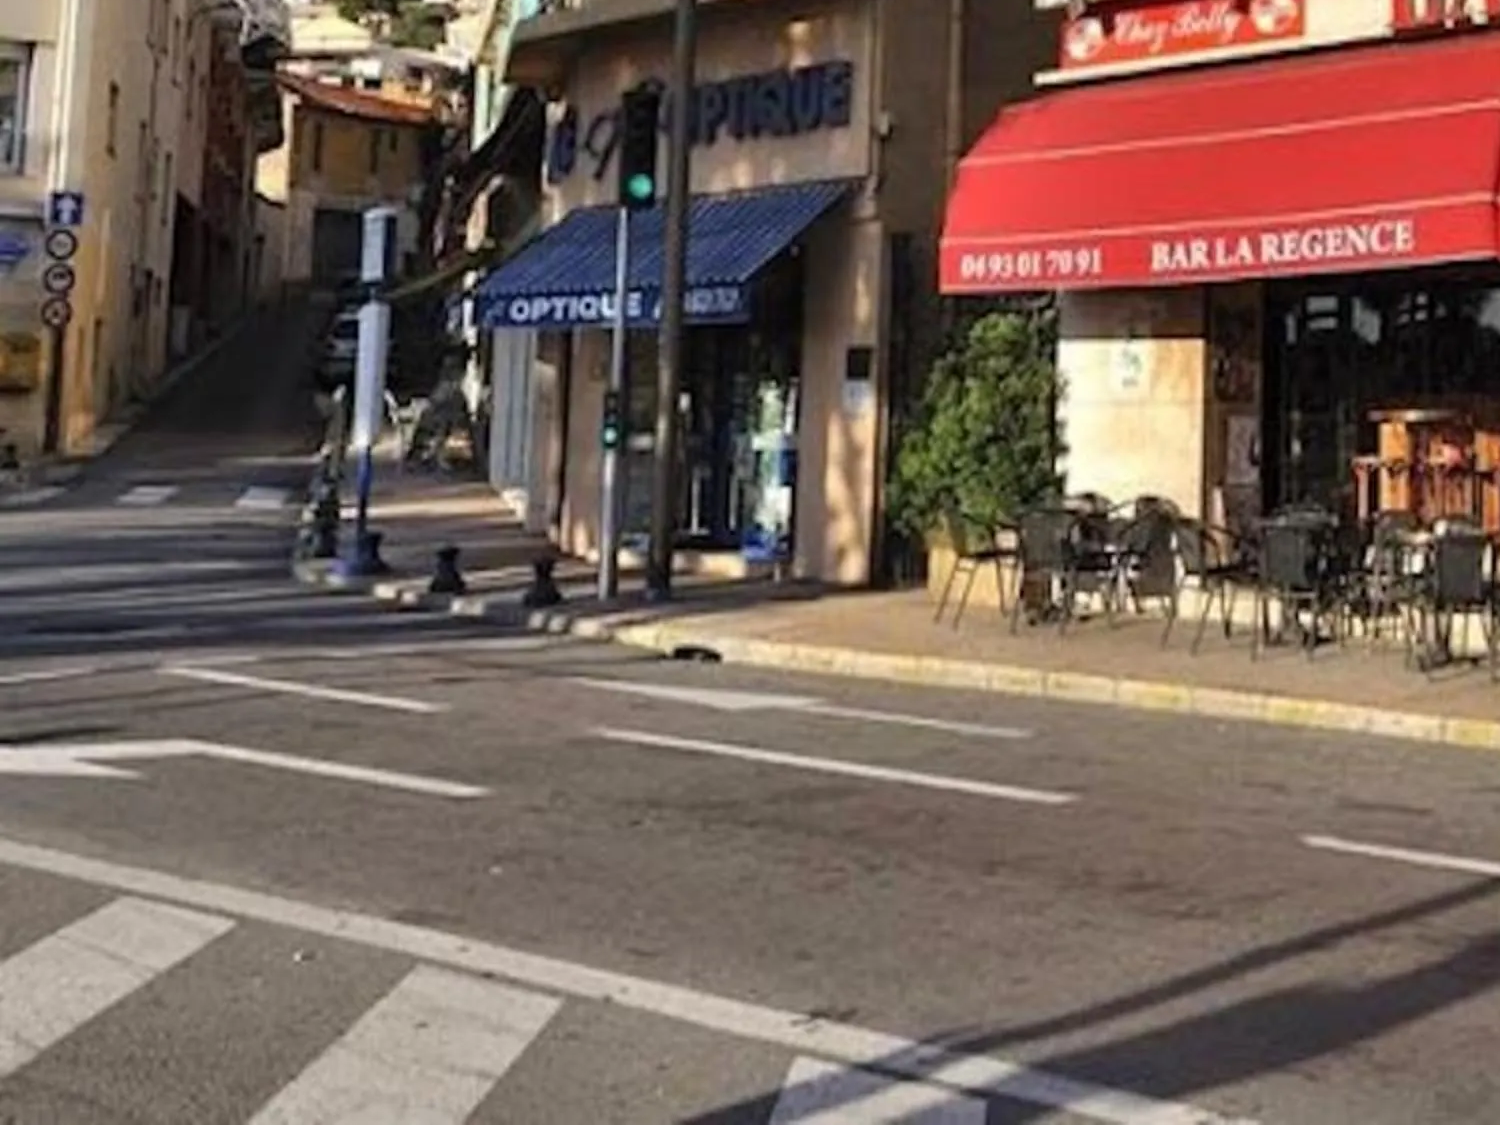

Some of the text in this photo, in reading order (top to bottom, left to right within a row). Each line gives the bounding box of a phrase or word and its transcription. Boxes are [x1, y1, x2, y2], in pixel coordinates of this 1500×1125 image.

[1151, 220, 1416, 271] BAR LA REGENCE
[508, 291, 642, 322] OPTIQUE
